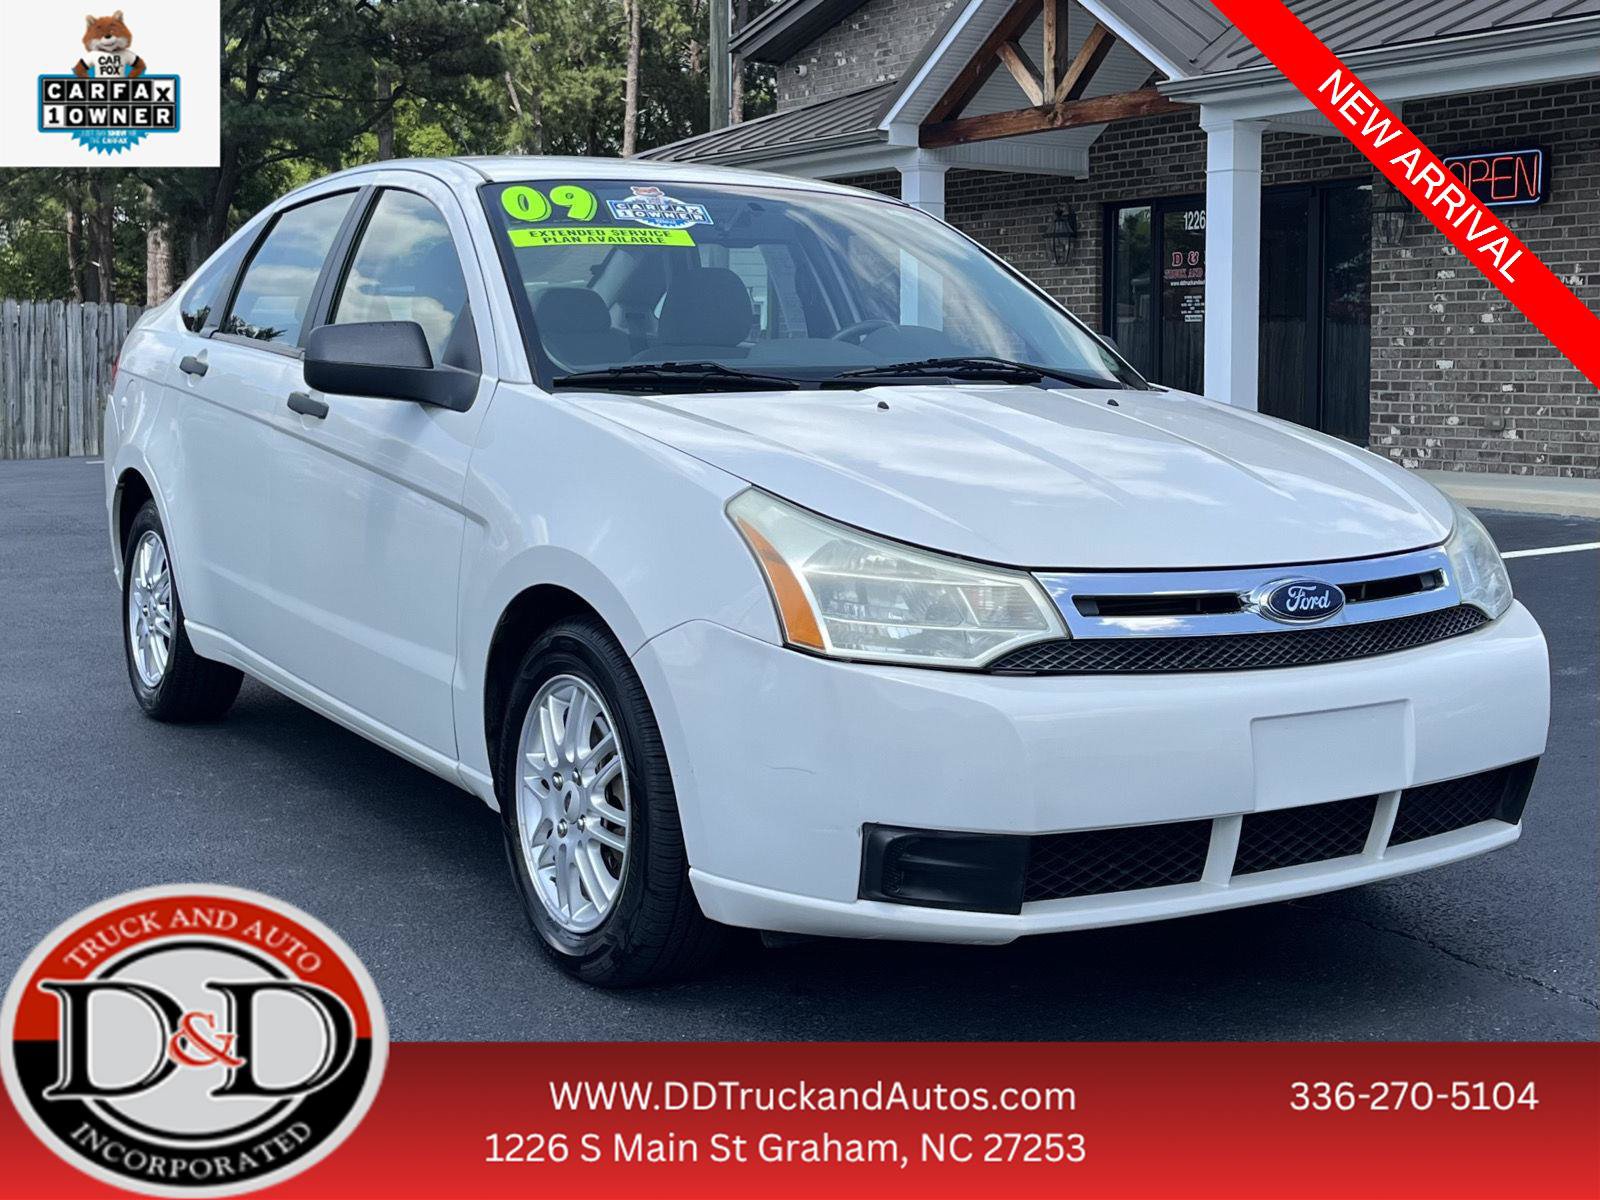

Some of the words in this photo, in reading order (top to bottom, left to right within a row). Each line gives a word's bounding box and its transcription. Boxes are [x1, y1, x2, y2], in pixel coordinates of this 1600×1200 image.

[501, 185, 598, 222] 09
[615, 202, 702, 216] CARFAX
[635, 210, 705, 221] OWNER
[1183, 210, 1206, 231] 1226
[529, 230, 605, 238] EXTENDED
[611, 229, 672, 238] SERVICE
[543, 236, 584, 244] PLAN
[587, 236, 667, 244] AVAILABLE
[1172, 251, 1183, 267] D
[1187, 251, 1200, 266] &
[1286, 585, 1331, 612] Ford
